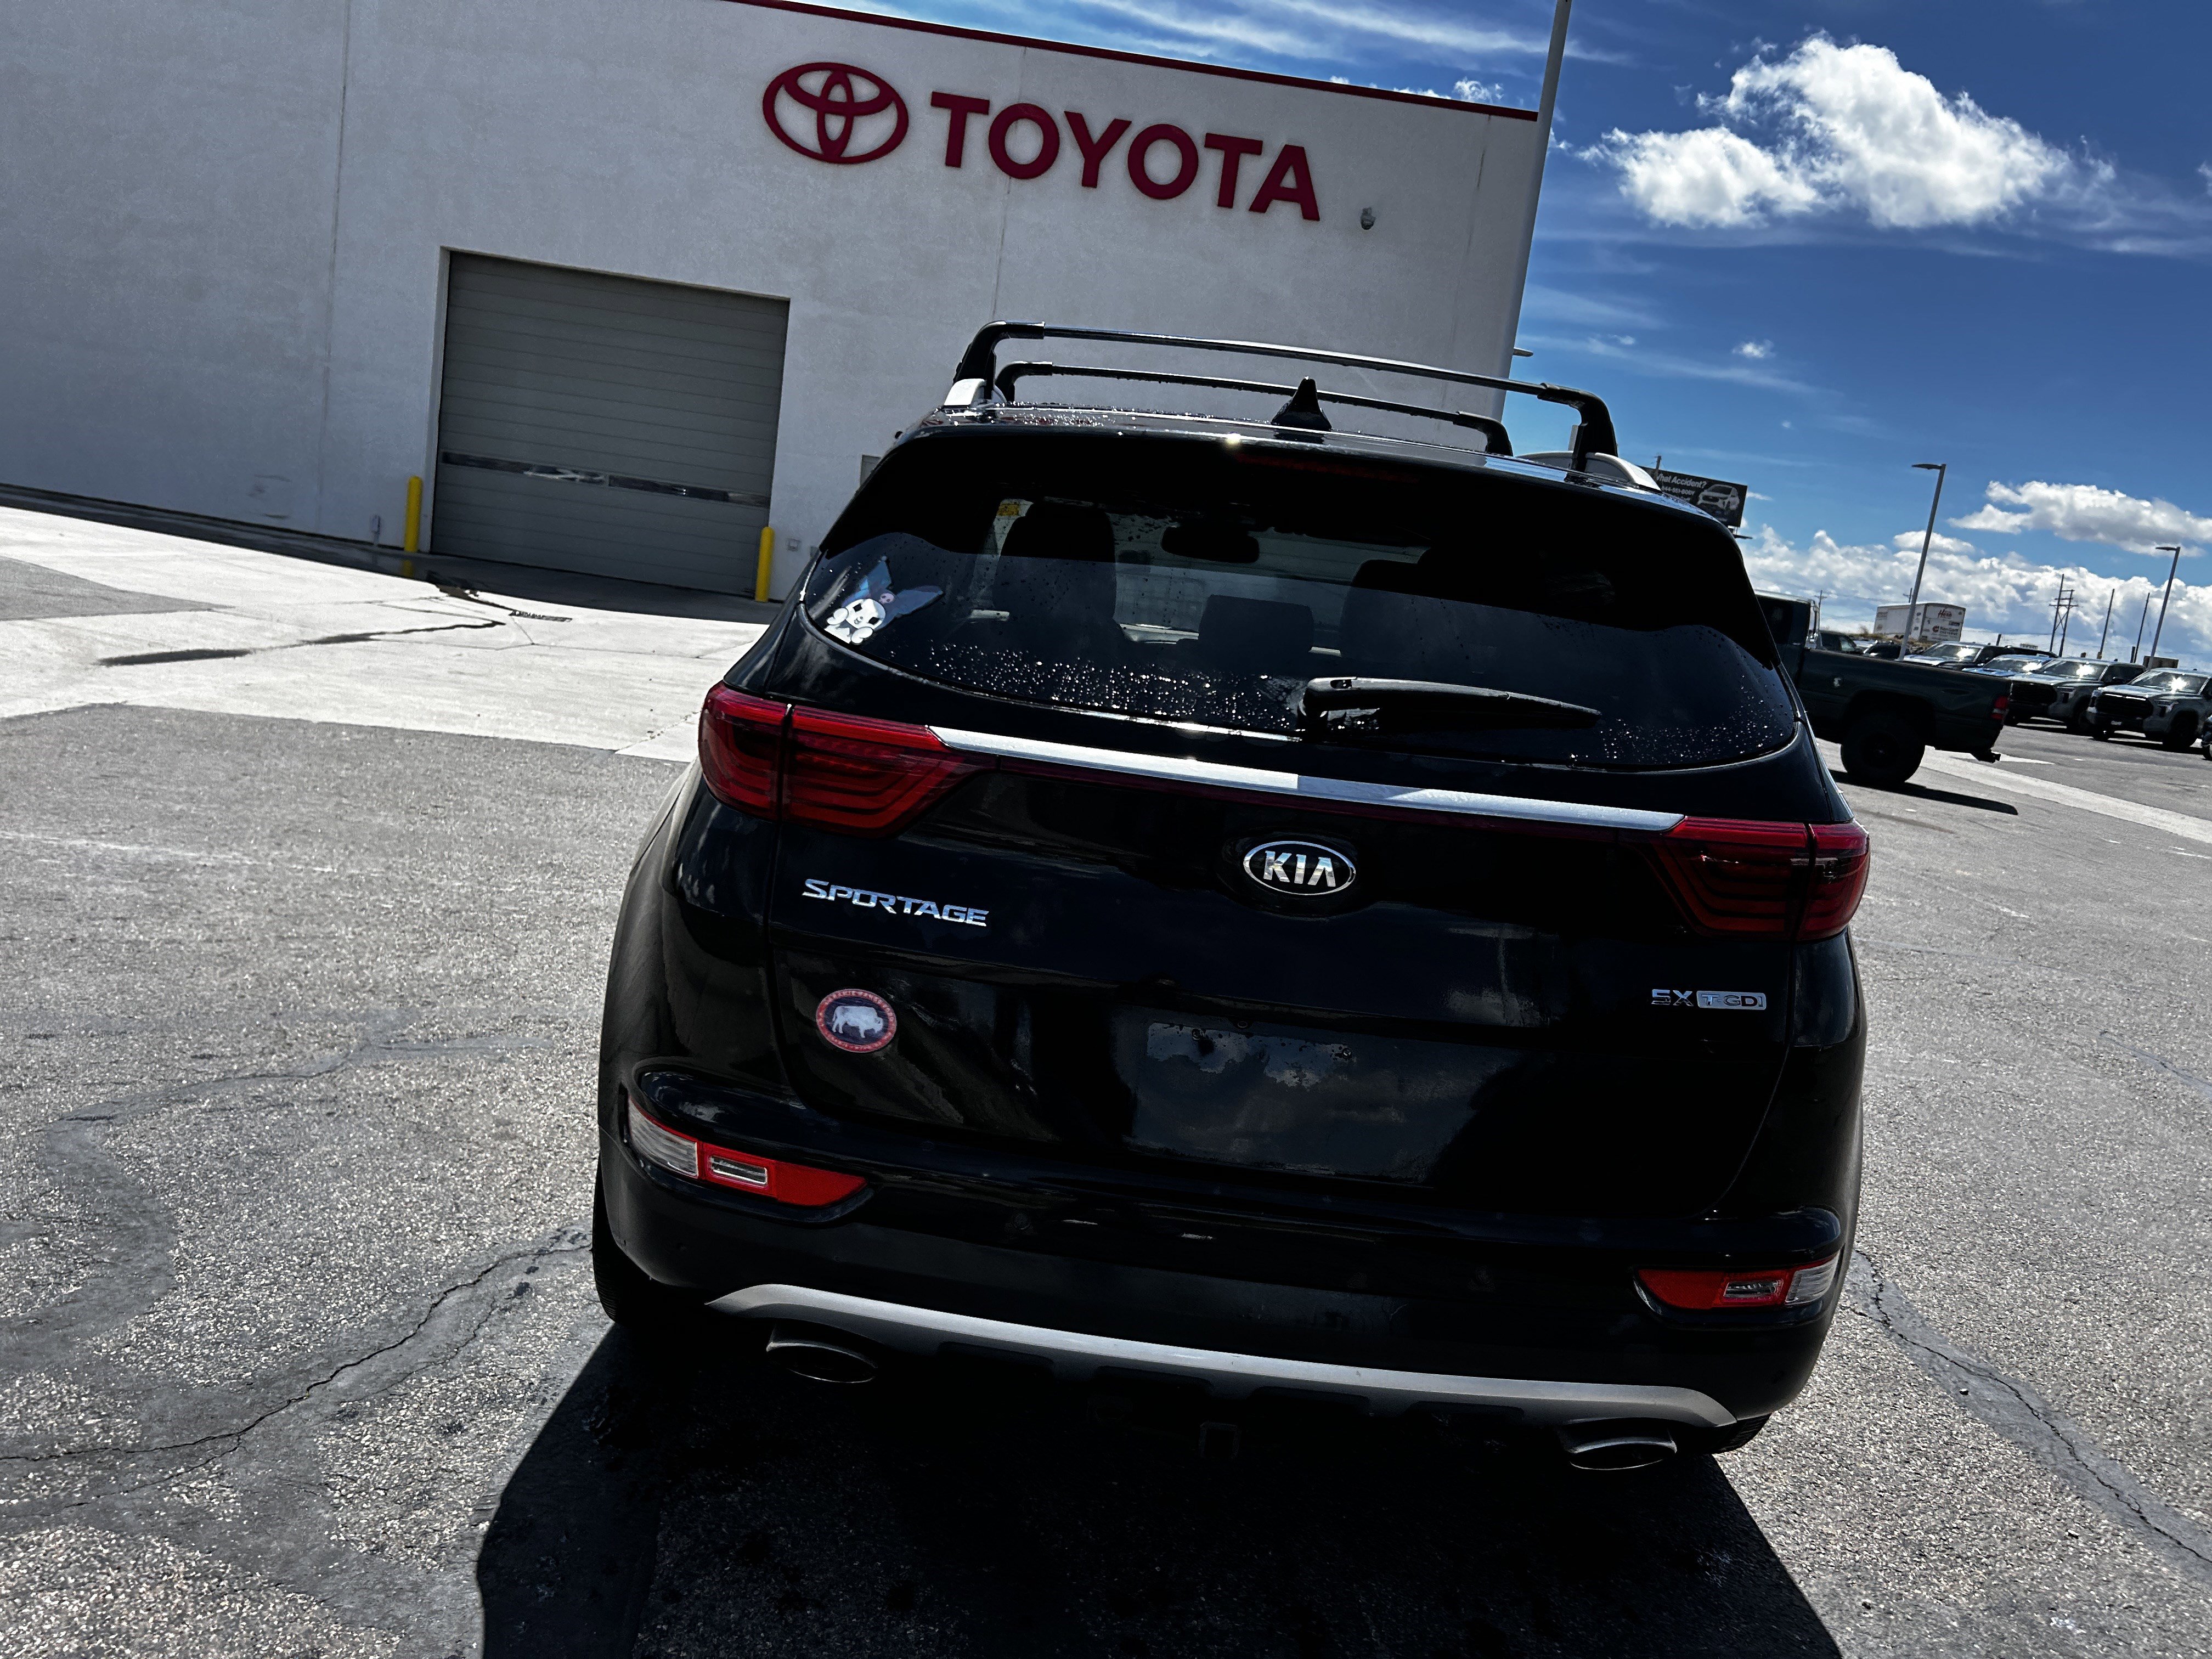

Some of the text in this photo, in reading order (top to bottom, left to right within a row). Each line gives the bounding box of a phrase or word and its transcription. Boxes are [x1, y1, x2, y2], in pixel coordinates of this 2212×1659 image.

[931, 92, 1319, 221] TOYOTA
[1671, 476, 1707, 489] Accident?
[1263, 850, 1336, 887] KIA
[802, 878, 989, 927] SPORTAGE
[1651, 989, 1694, 1007] SX
